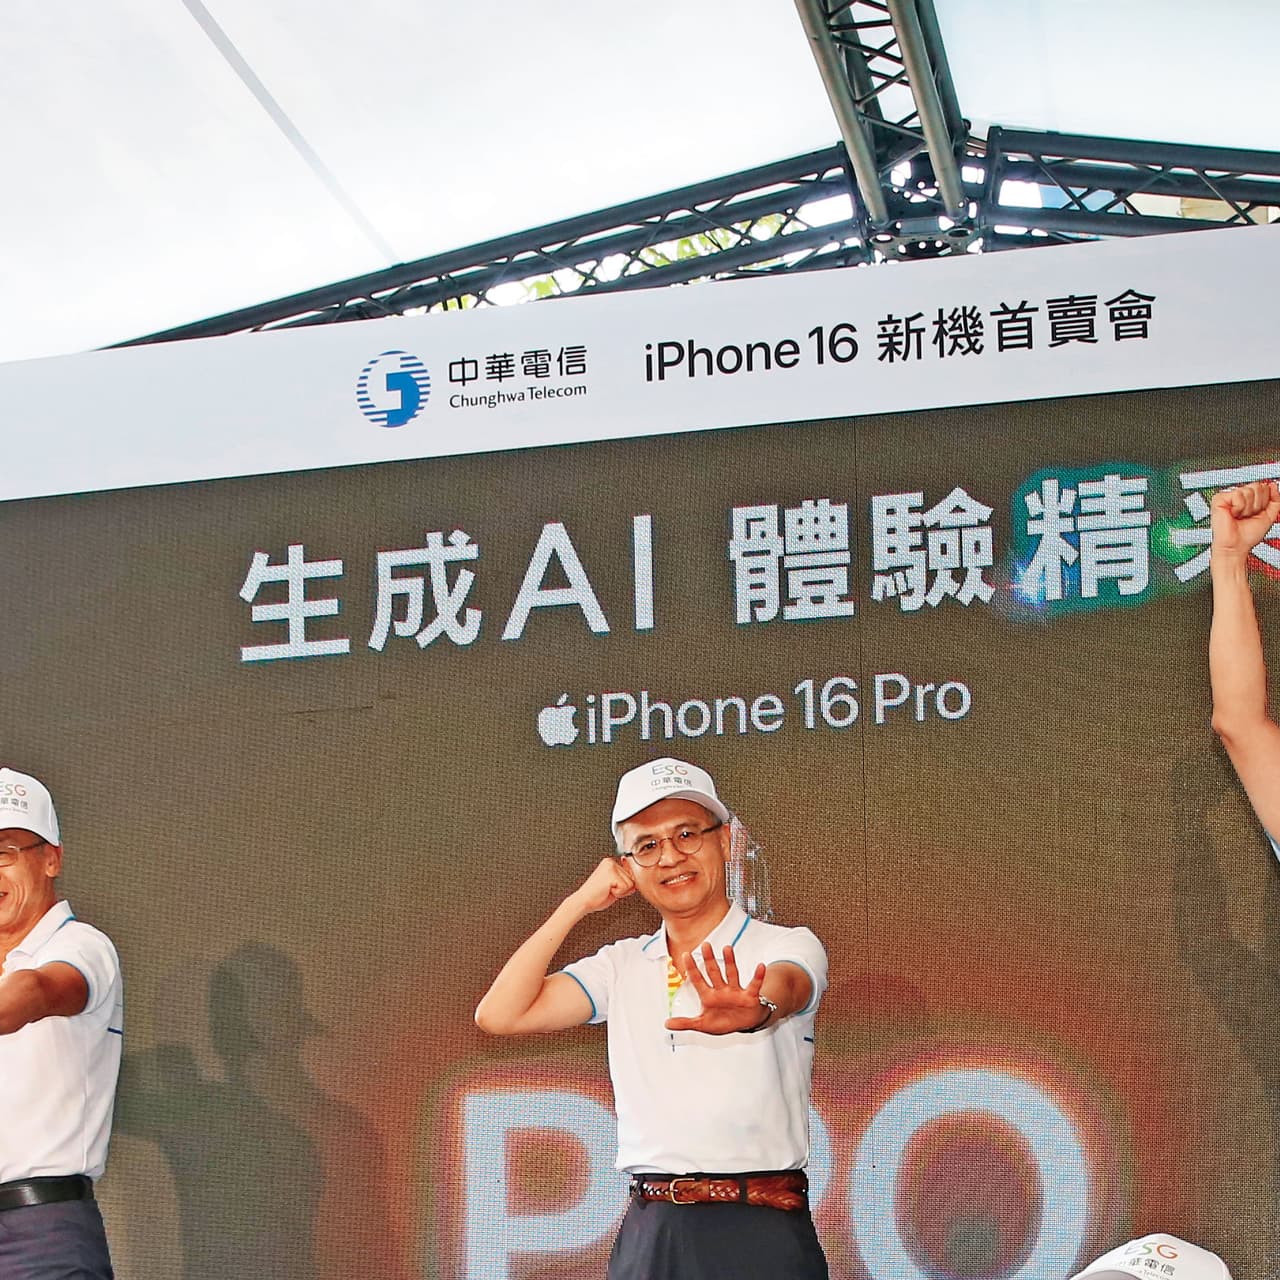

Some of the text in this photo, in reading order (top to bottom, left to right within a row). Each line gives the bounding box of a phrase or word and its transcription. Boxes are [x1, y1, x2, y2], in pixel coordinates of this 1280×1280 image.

[448, 345, 587, 387] 中華電信
[645, 288, 1157, 382] iPhone 16 新機首賣會
[449, 385, 587, 409] Chunghwa Telecom
[239, 514, 654, 662] 生成AI
[585, 672, 972, 745] iPhone 16 Pro
